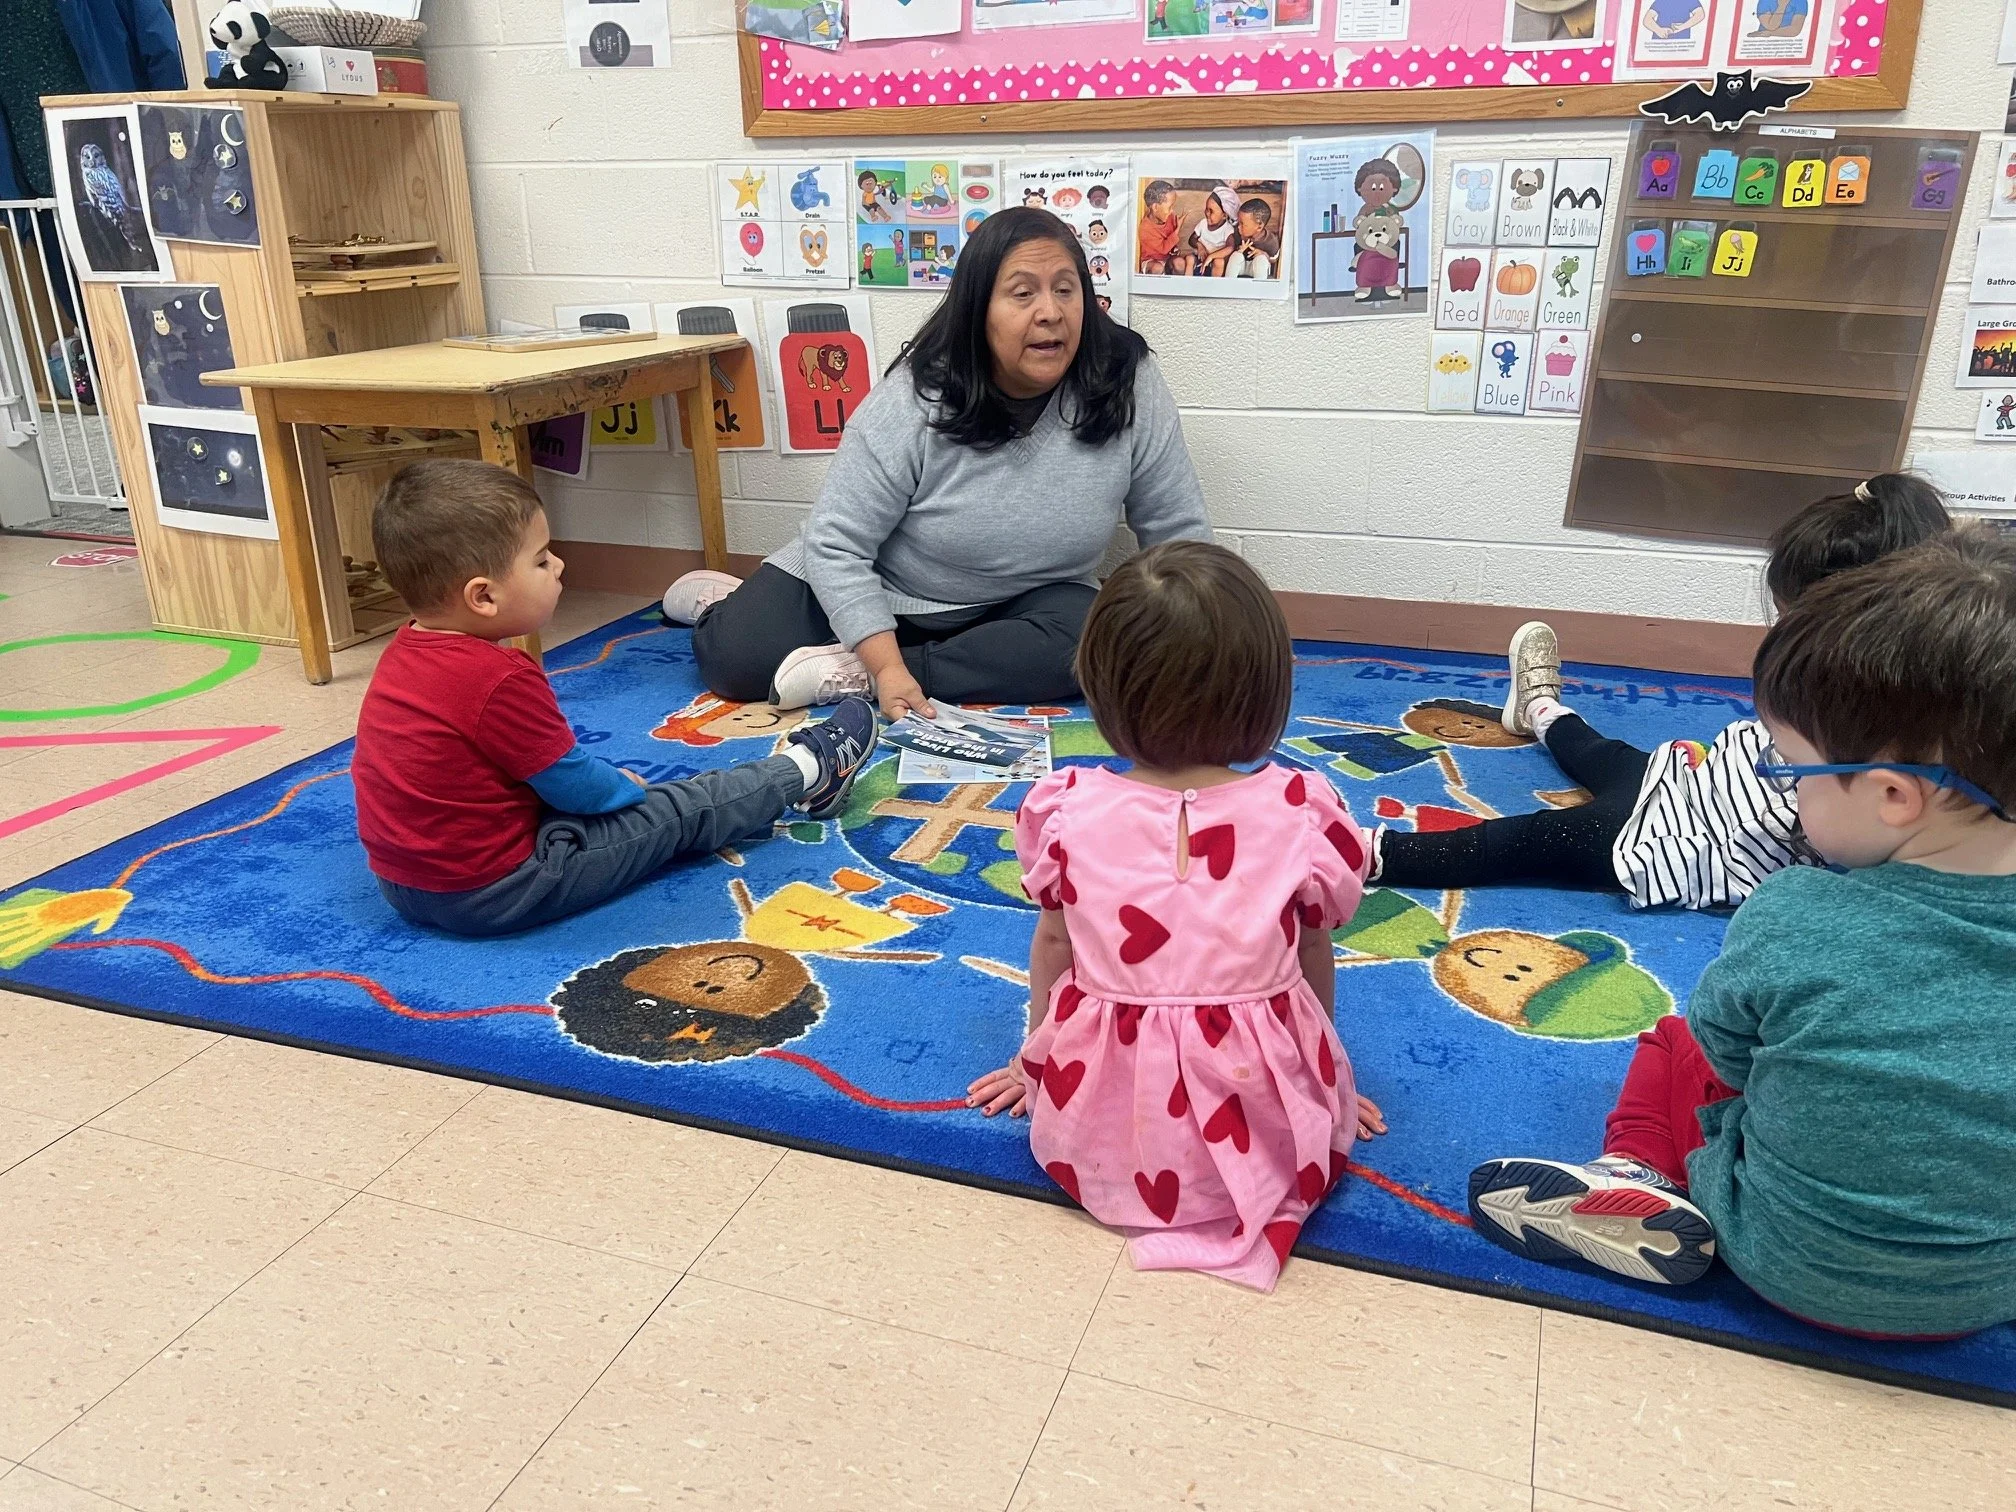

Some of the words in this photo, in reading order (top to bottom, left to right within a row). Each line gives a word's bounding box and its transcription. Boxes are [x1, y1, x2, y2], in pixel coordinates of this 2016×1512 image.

[1780, 127, 1817, 136] ALPHABETS
[1020, 171, 1037, 180] How
[1039, 170, 1049, 178] do
[1051, 171, 1066, 181] you
[1068, 169, 1084, 178] feel
[1086, 168, 1114, 180] today?
[1701, 164, 1728, 189] Bb
[1646, 178, 1668, 192] Aa
[1745, 185, 1764, 200] Cc
[1835, 183, 1855, 198] Ee
[1792, 187, 1813, 202] Dd
[1922, 188, 1946, 204] Gg
[1452, 215, 1488, 243] Gray
[1502, 215, 1541, 238] Brown
[1552, 217, 1569, 238] Black
[1570, 219, 1577, 238] &
[1578, 217, 1599, 238] White
[1636, 256, 1656, 270] Hh
[1681, 256, 1692, 271] Ii
[1722, 256, 1744, 272] Jj
[1986, 278, 2016, 286] Bathro
[1442, 300, 1479, 323] Red
[1494, 299, 1530, 328] Orange
[1543, 301, 1581, 324] Green
[1977, 320, 2001, 328] Large
[1483, 383, 1520, 407] Blue
[1538, 380, 1576, 403] Pink
[600, 402, 638, 435] Jj
[814, 398, 845, 434] Ll
[1967, 493, 2006, 503] Activities
[905, 728, 960, 748] Arctic?
[911, 738, 952, 756] Lives
[954, 748, 988, 760] Who
[961, 743, 987, 752] the
